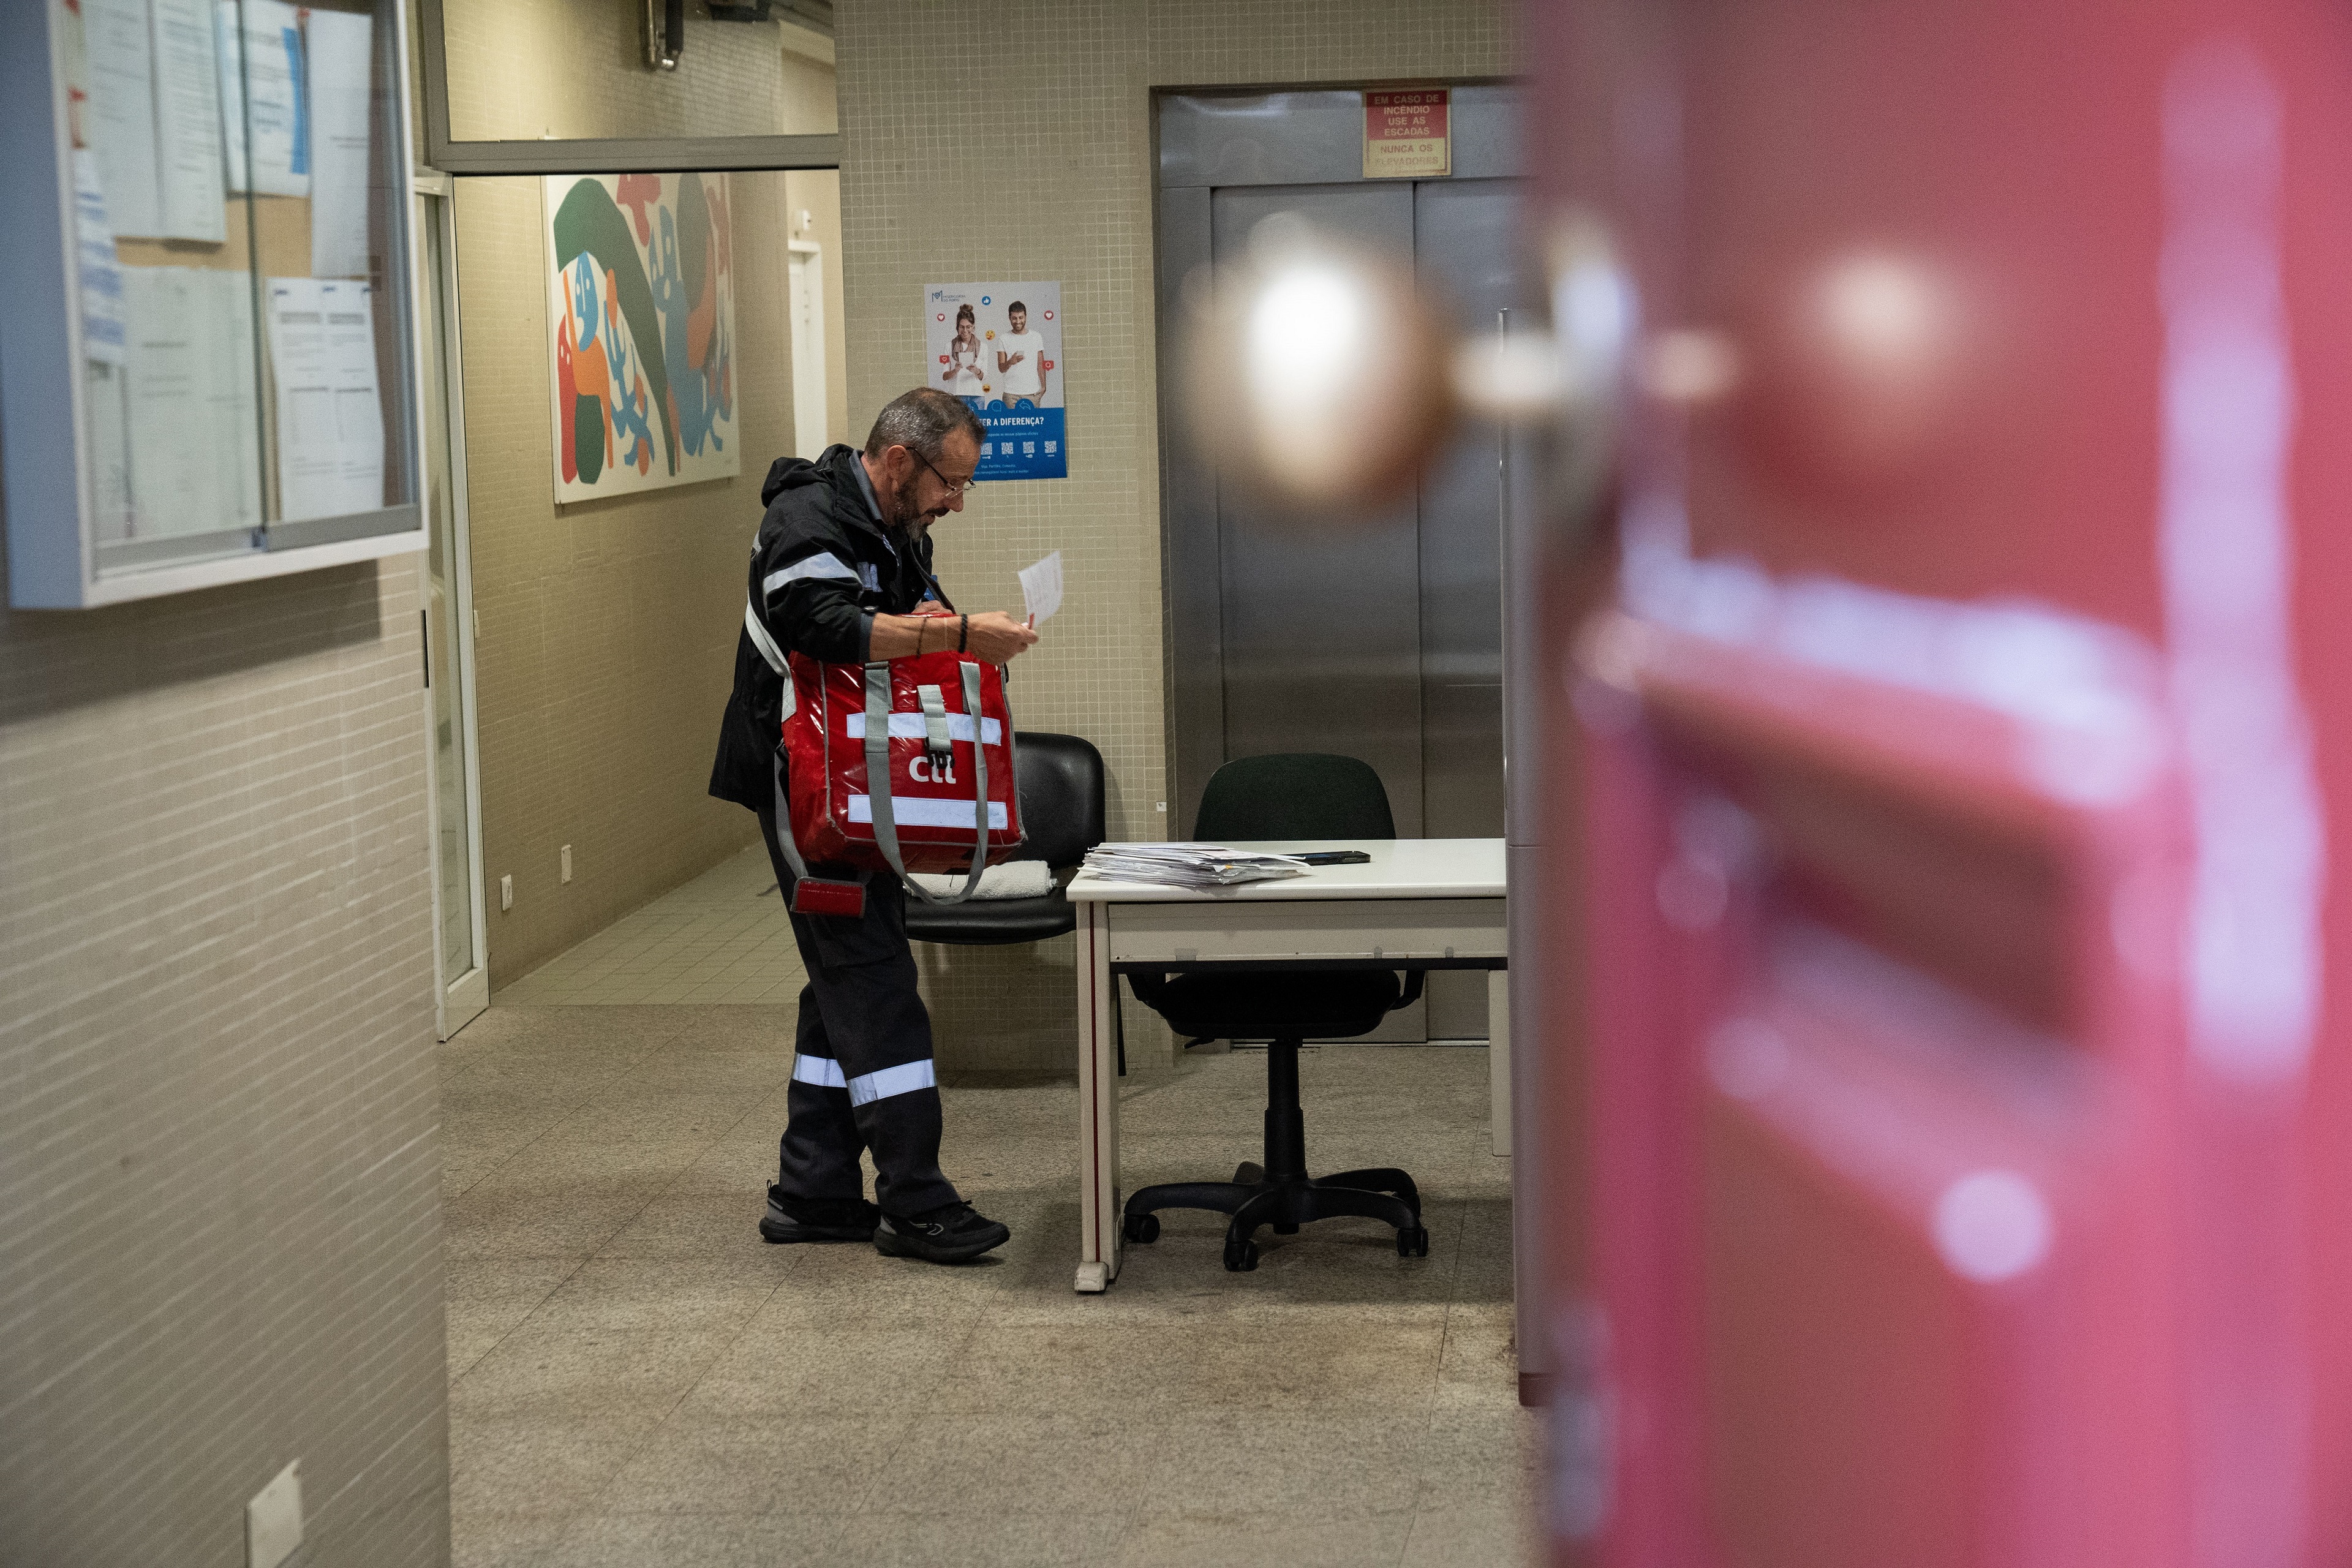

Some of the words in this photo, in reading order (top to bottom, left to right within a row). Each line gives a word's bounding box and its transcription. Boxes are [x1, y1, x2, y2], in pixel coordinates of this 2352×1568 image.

[1374, 96, 1389, 104] EM
[1393, 94, 1421, 104] CASO
[1426, 94, 1439, 103] DE
[1384, 105, 1430, 115] INCÊNDIO
[1388, 116, 1408, 125] USE
[1384, 127, 1430, 136] ESCADAS
[1381, 144, 1414, 154] NUNCA
[1419, 143, 1433, 153] OS
[993, 418, 998, 426] A
[1000, 417, 1044, 427] DIFERENÇA?
